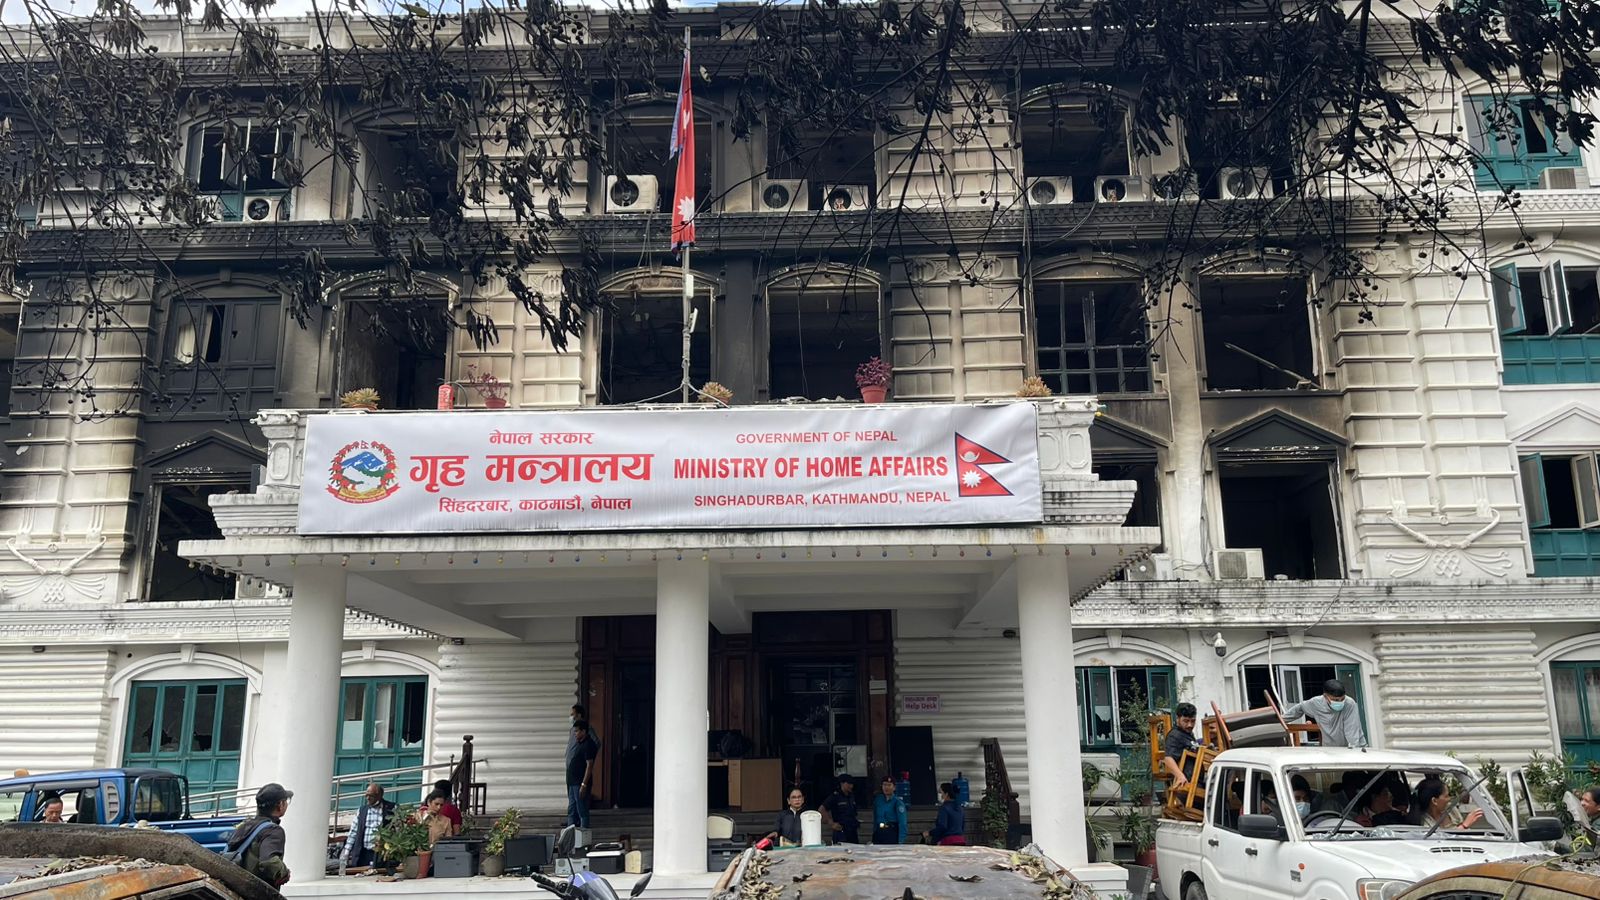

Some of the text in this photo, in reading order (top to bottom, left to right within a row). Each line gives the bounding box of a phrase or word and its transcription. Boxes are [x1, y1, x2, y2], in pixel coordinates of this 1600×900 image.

[489, 429, 595, 445] नेपाल सरकार
[735, 430, 898, 444] GOVERNMENT OF NEPAL
[409, 453, 655, 492] गृह मन्त्रालय
[673, 456, 948, 479] MINISTRY OF HOME AFFAIRS
[439, 496, 512, 513] सिंहदरबार,
[591, 495, 632, 510] नेपाल
[694, 491, 951, 507] SINGHADURBAR, KATHMANDU, NEPAL
[905, 702, 920, 710] Help
